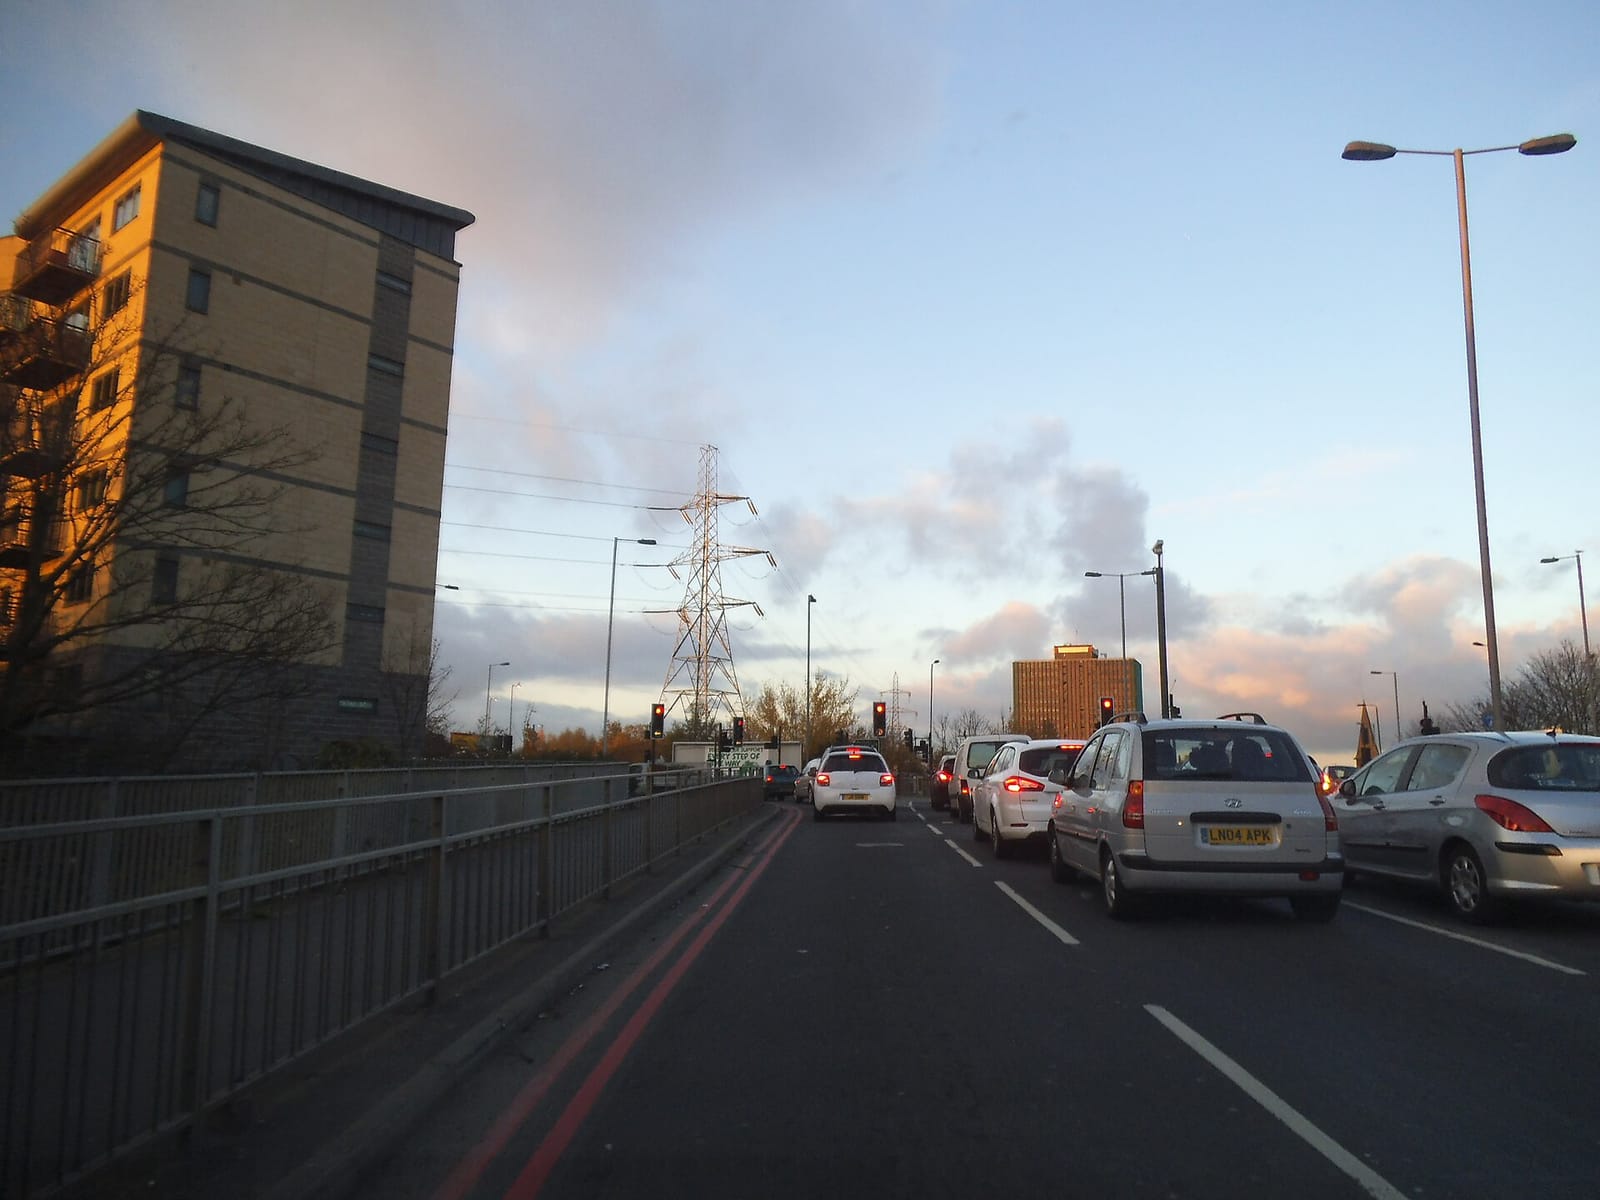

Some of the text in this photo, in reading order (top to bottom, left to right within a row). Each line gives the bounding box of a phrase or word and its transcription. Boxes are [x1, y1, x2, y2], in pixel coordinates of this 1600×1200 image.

[732, 752, 749, 760] STEP
[750, 752, 761, 760] OF
[1209, 828, 1271, 841] LN04 APK
